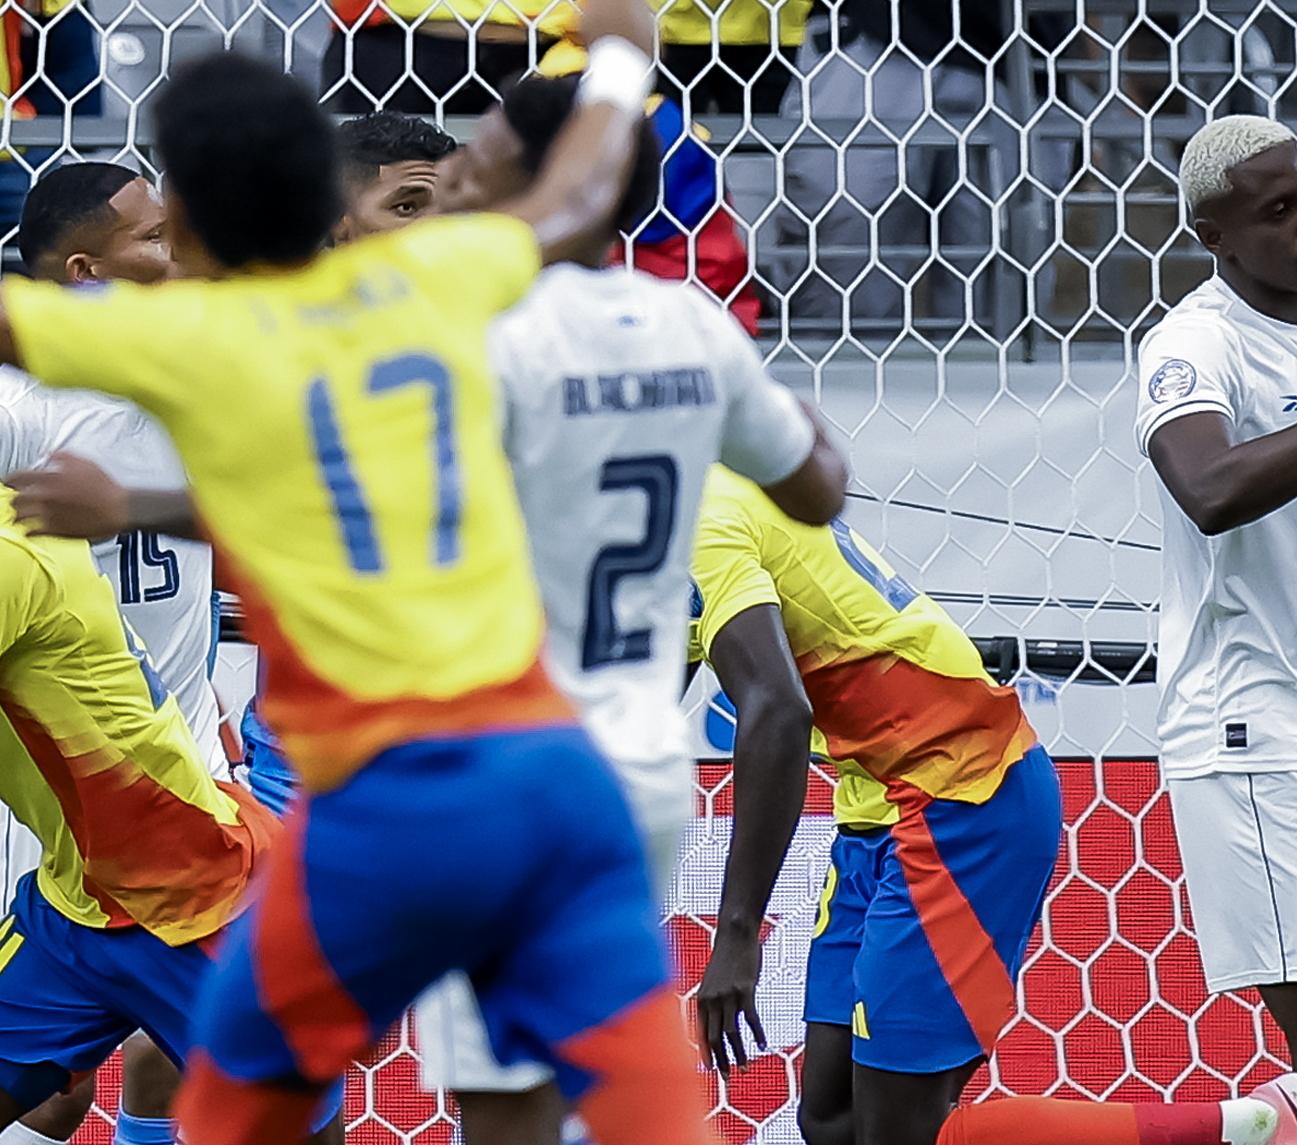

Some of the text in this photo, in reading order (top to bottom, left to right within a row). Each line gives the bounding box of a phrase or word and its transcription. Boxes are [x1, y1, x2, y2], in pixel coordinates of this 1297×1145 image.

[116, 530, 180, 604] 15
[309, 354, 458, 572] 17
[582, 455, 676, 672] 2
